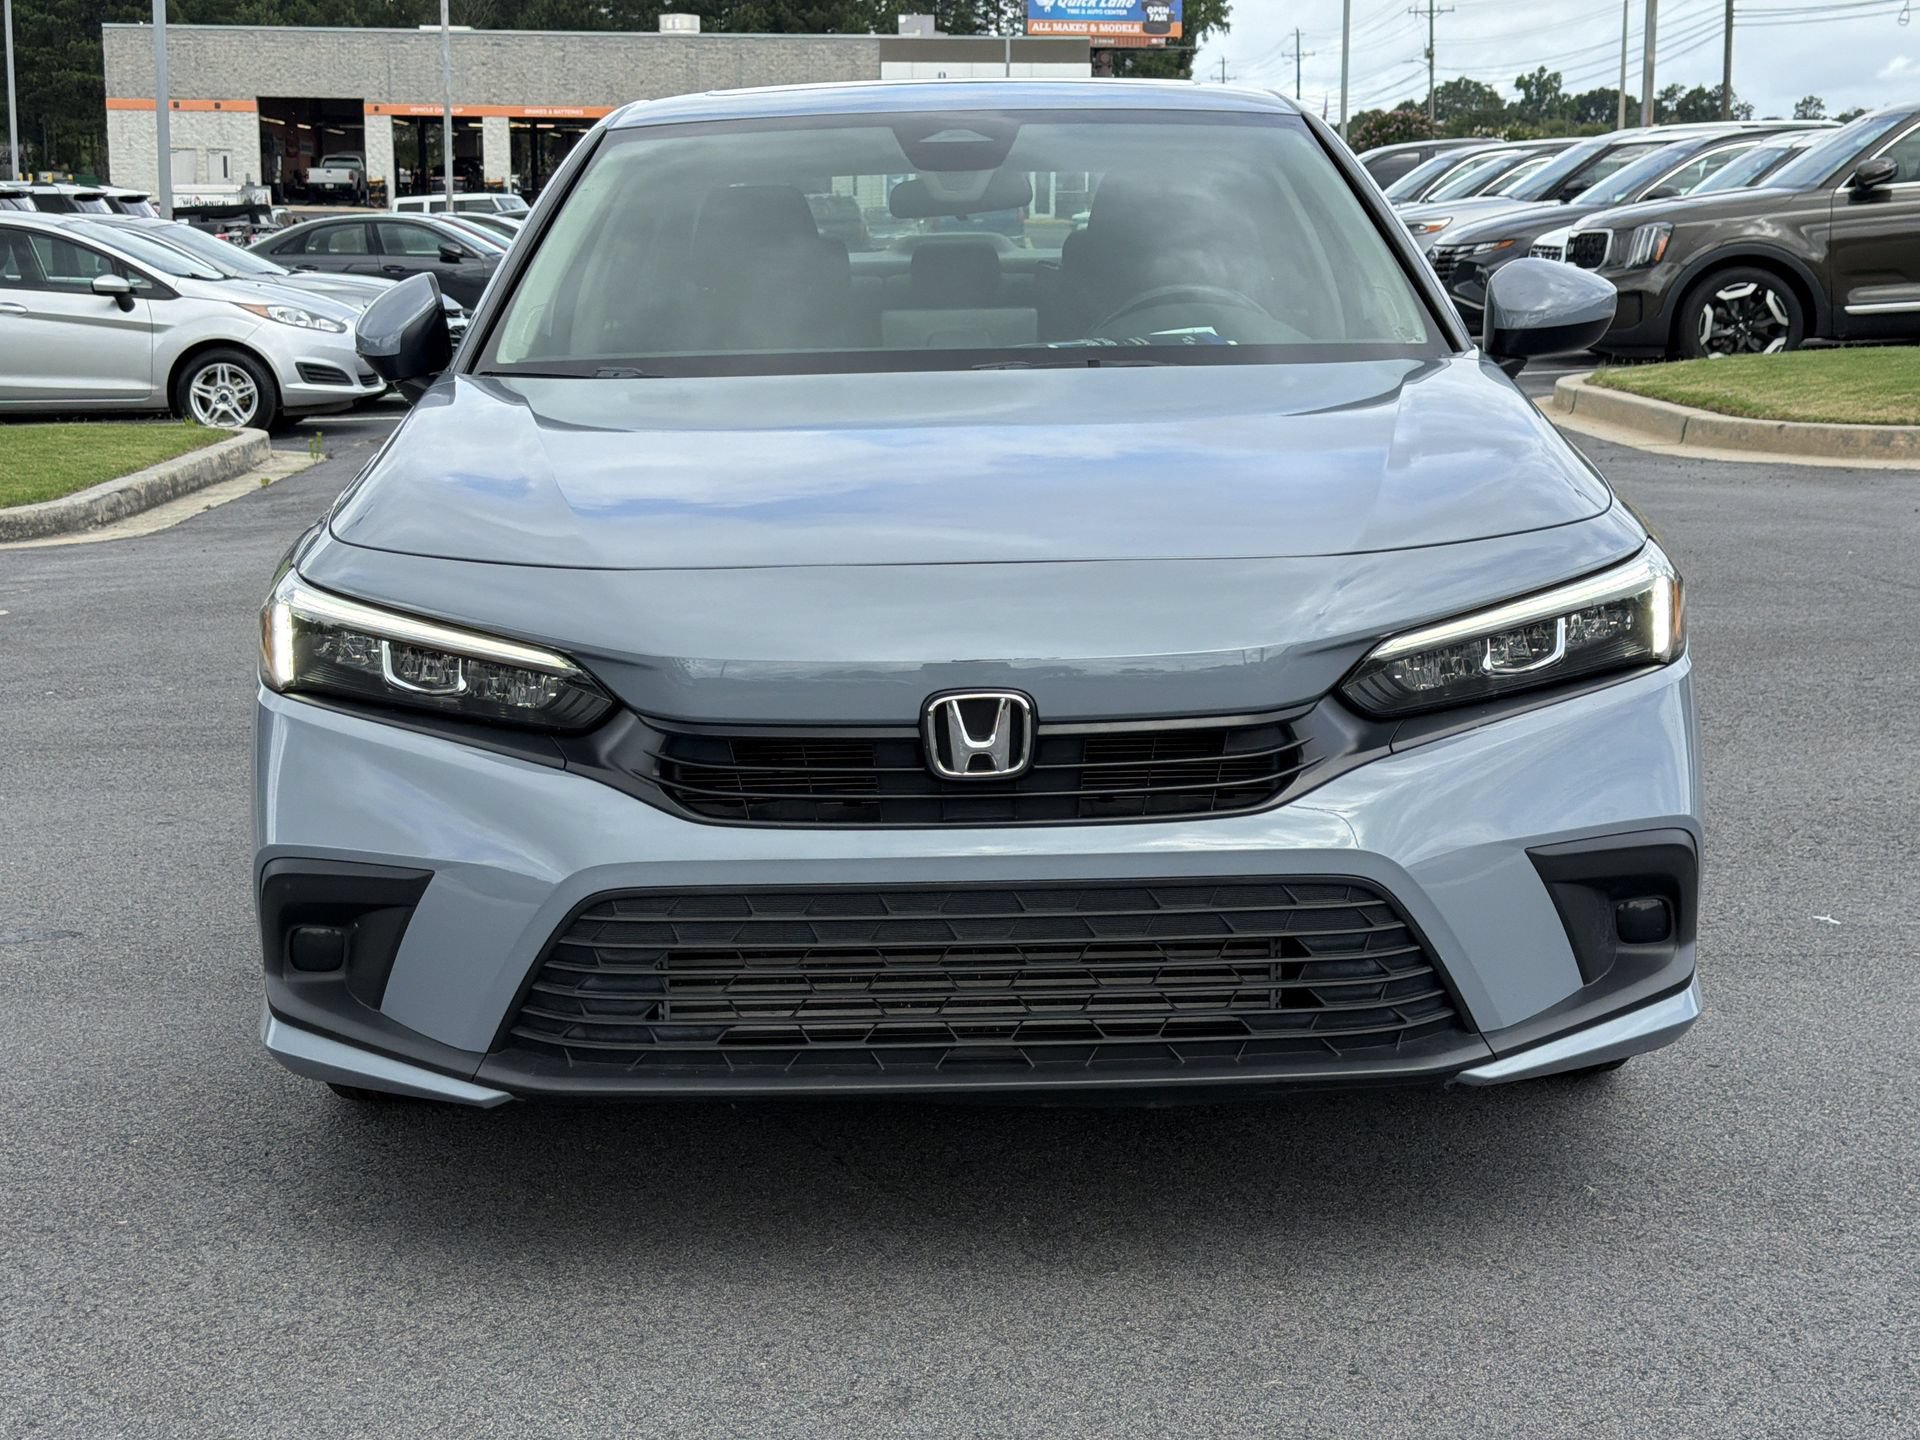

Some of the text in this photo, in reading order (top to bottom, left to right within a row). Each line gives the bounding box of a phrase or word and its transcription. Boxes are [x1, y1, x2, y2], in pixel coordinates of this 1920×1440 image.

[1099, 0, 1137, 8] Lane
[1146, 5, 1170, 14] OPEN
[1149, 14, 1168, 22] 7AM
[1032, 22, 1140, 33] ALL MAKES & MODELS
